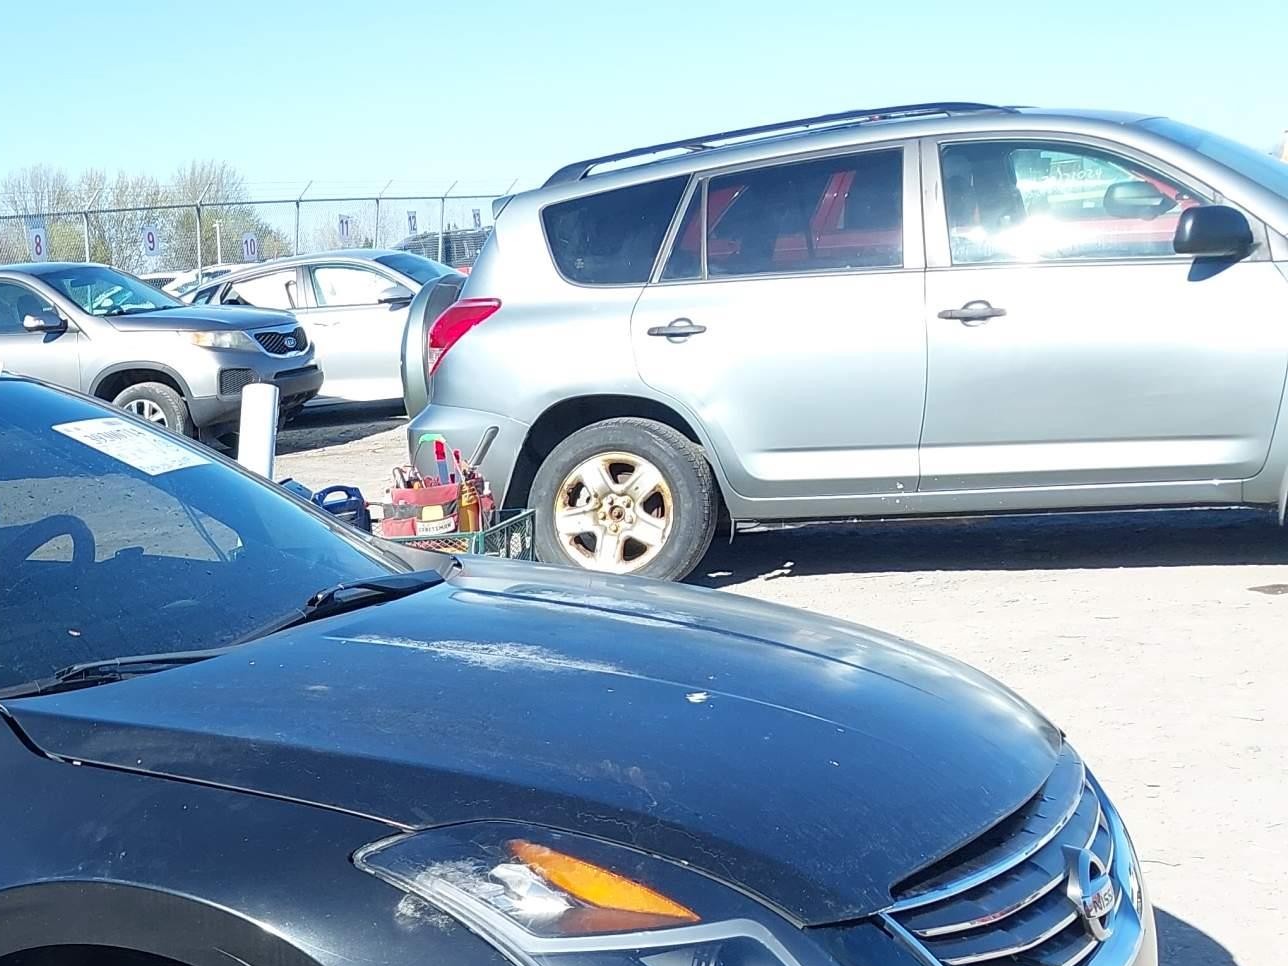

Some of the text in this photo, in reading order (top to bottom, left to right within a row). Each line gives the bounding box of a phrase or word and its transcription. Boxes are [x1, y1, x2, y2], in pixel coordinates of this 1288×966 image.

[339, 220, 349, 237] 11
[407, 214, 417, 231] 12
[34, 234, 43, 256] 8
[147, 231, 156, 251] 9
[243, 239, 257, 256] 10
